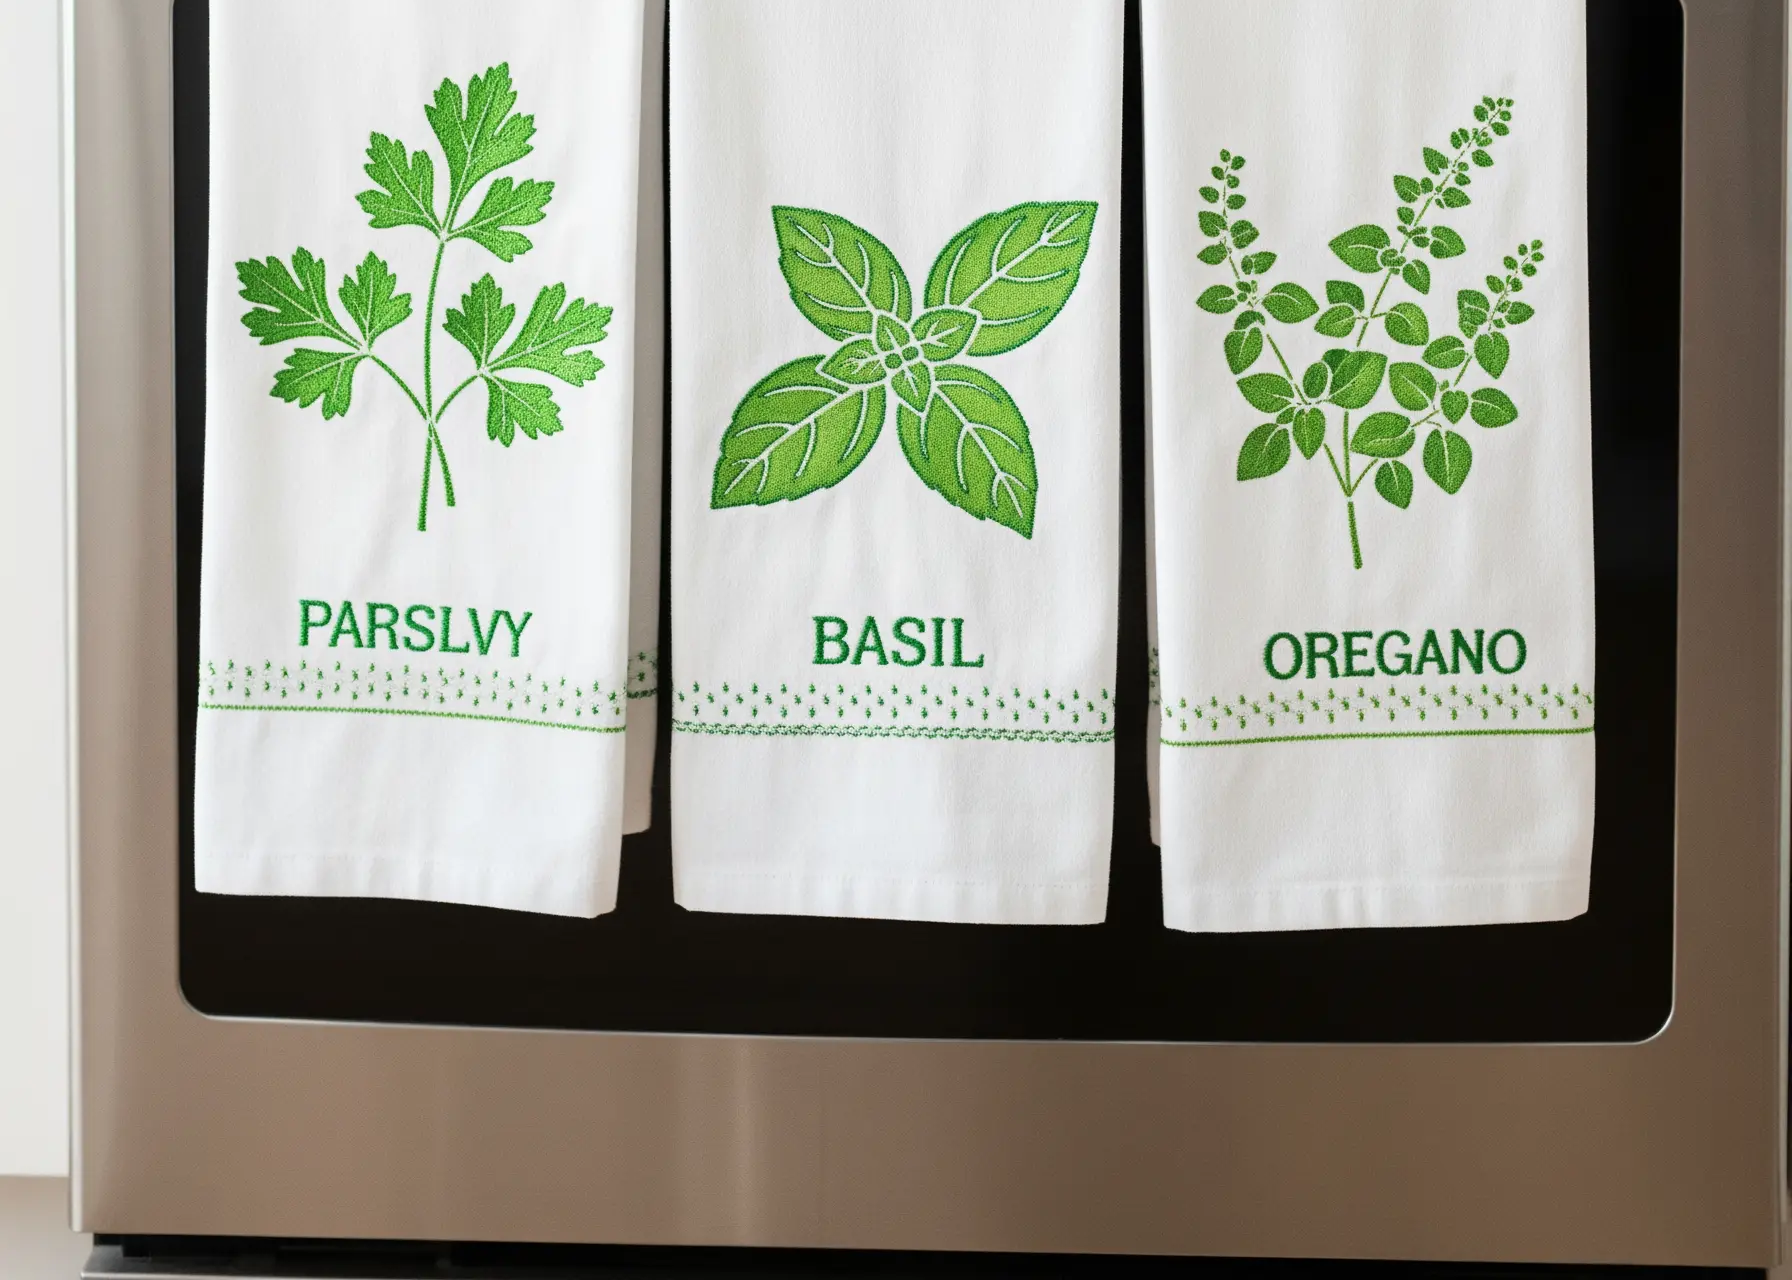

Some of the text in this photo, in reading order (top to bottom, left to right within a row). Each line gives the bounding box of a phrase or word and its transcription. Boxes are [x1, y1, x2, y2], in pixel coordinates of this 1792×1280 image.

[298, 599, 533, 658] PARSLVY
[813, 616, 985, 668] BASIL
[1264, 629, 1527, 679] OREGANO
